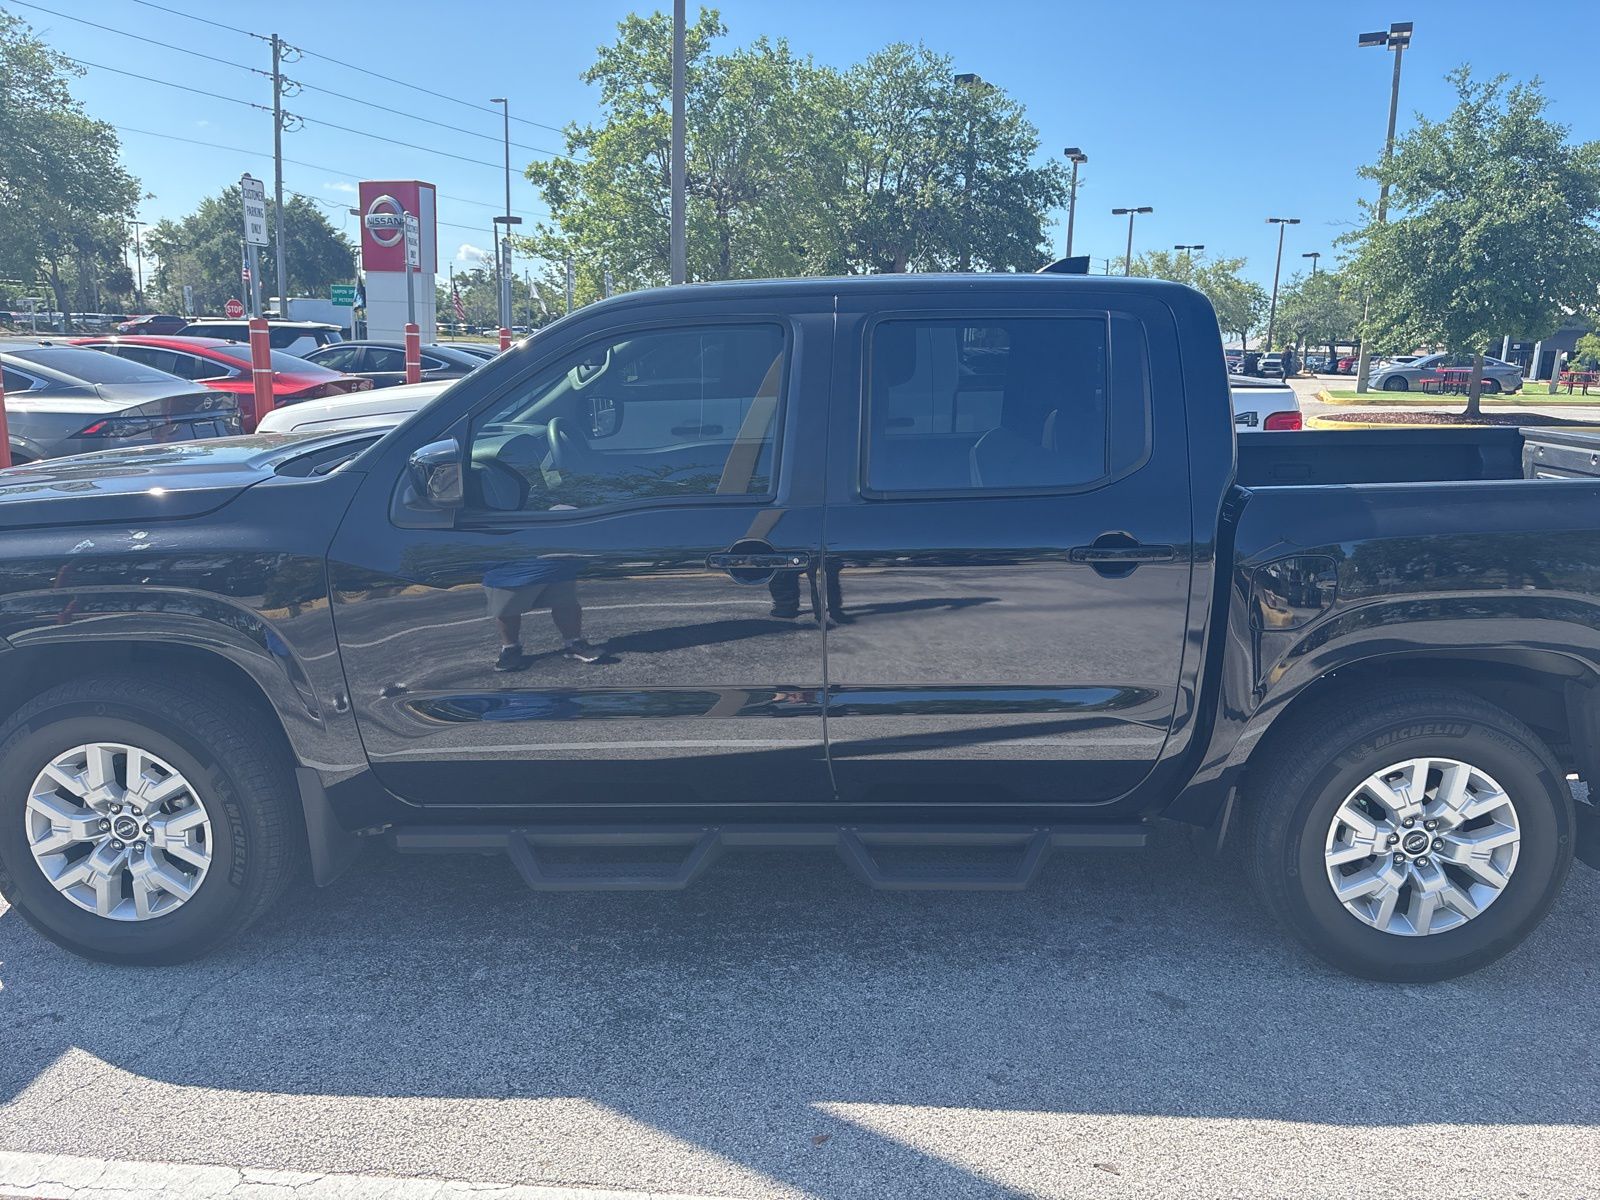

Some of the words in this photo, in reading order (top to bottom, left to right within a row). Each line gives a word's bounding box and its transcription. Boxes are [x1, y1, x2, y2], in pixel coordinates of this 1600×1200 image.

[246, 205, 264, 219] PARKING
[366, 216, 403, 226] NISSAN
[250, 222, 262, 235] ONLY
[226, 306, 243, 314] STOP
[1375, 722, 1467, 749] MICHELIN
[225, 802, 247, 886] MICHELIN
